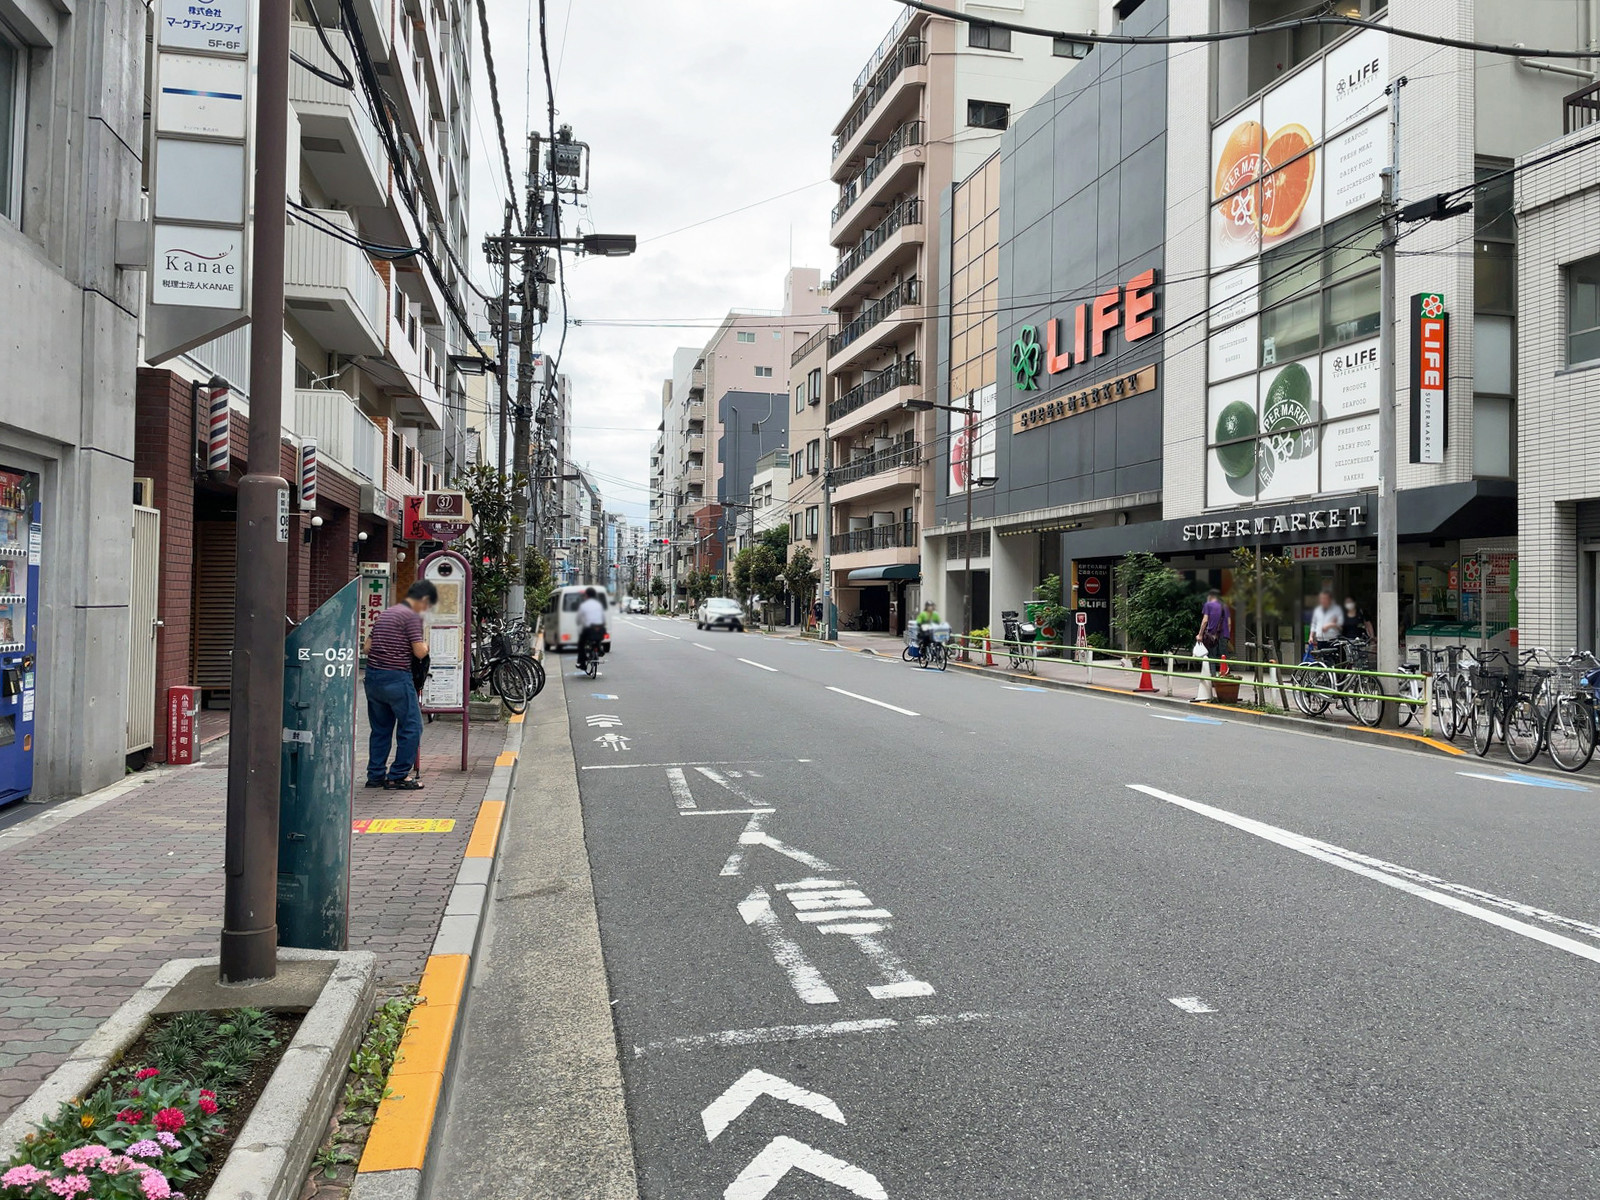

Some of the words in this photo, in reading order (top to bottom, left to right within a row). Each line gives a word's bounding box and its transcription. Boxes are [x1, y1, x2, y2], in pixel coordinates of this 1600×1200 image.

[188, 6, 222, 18] 株式会社
[1349, 58, 1379, 87] LIFE
[1344, 128, 1369, 146] SEAFOOD
[1340, 149, 1357, 164] FRESH
[1358, 142, 1373, 157] MEAT
[1340, 165, 1358, 179] DAIRY
[1358, 157, 1373, 170] FOOD
[1336, 172, 1376, 196] DELICATESSEN
[165, 255, 235, 275] Kanae
[162, 279, 234, 292] 税理士法人KANAE
[1047, 268, 1156, 375] LIFE
[1346, 347, 1376, 368] LIFE
[1424, 322, 1440, 386] LIFE
[1342, 382, 1367, 393] PRODUCE
[1021, 372, 1138, 427] SUPERMARKET
[1342, 398, 1366, 408] SEAFOOD
[1338, 427, 1356, 436] FRESH
[1356, 424, 1371, 432] MEAT
[1338, 442, 1355, 452] DAIRY
[1356, 440, 1371, 448] FOOD
[1335, 456, 1374, 467] DELICATESSEN
[1344, 473, 1364, 481] BAKERY
[440, 497, 450, 507] 37
[1183, 506, 1366, 541] SUPERMARKET
[1294, 546, 1319, 559] LIFE
[1321, 545, 1356, 558] お客様入口
[324, 664, 353, 677] 017
